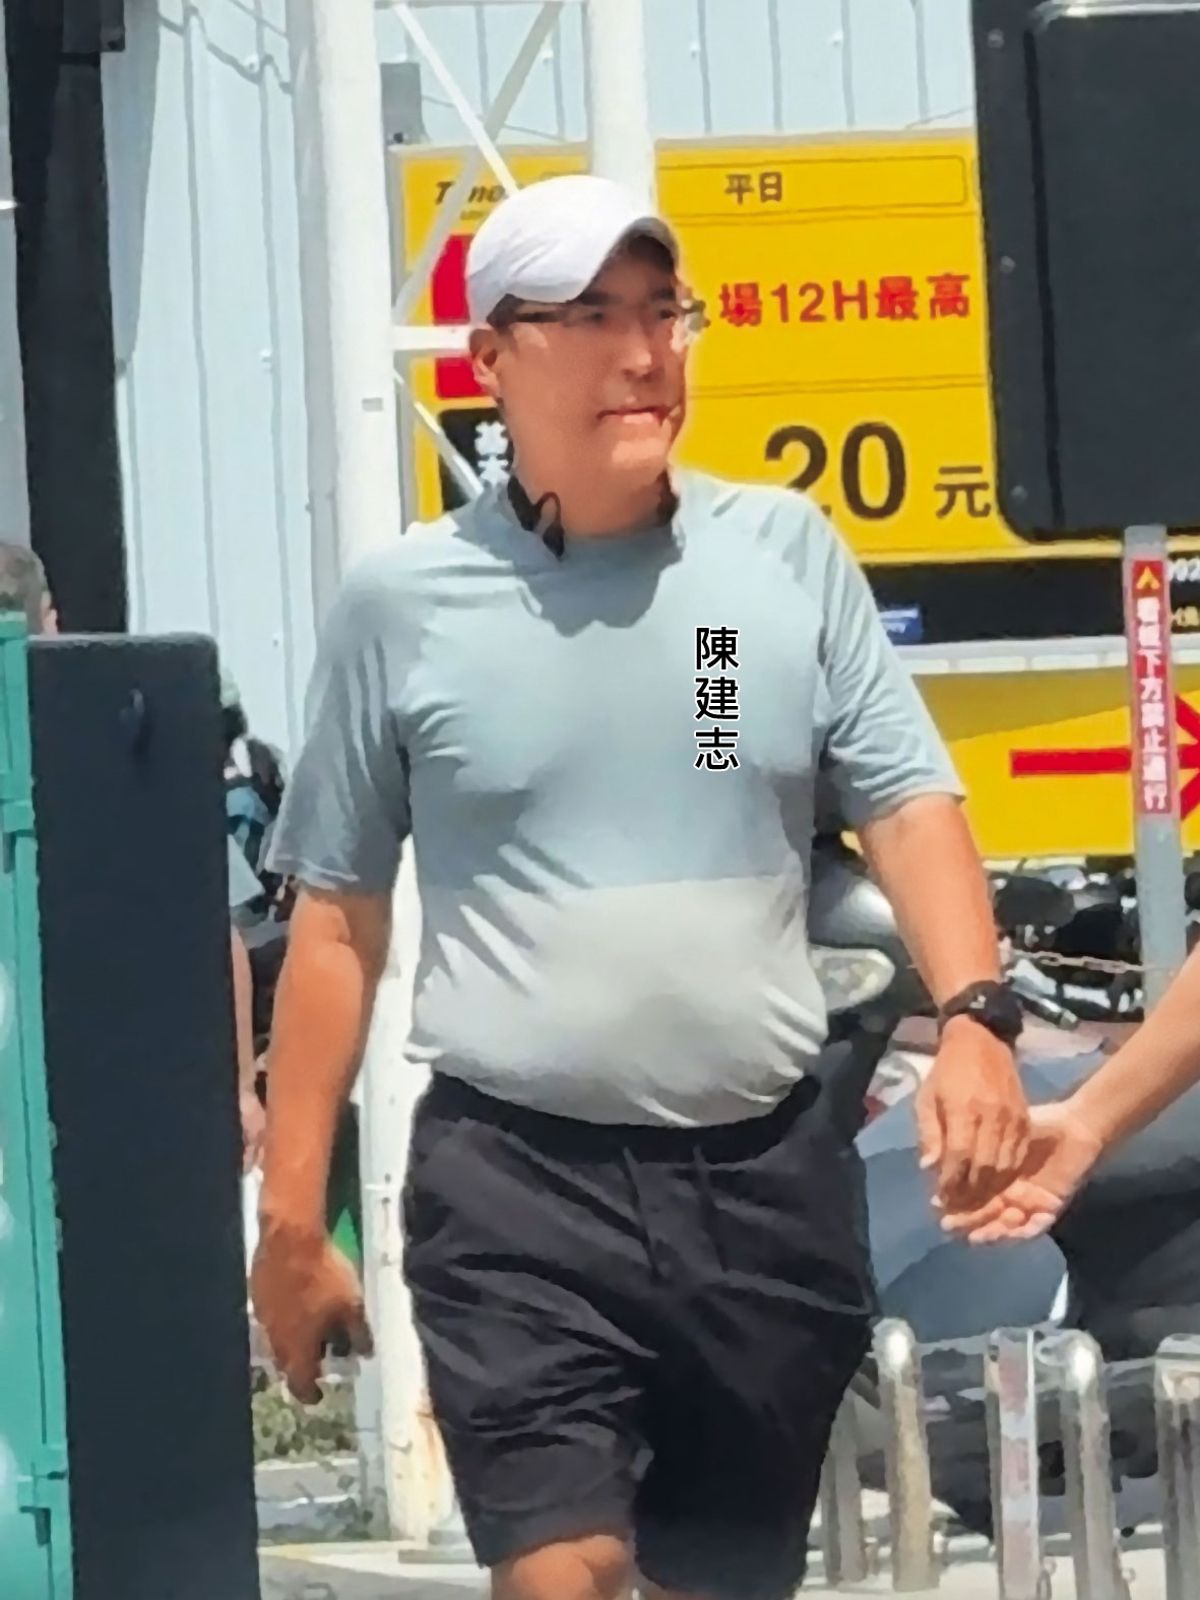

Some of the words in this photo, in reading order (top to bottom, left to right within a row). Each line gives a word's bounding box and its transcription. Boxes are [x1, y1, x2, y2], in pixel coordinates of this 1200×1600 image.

[724, 171, 783, 205] 平日
[718, 272, 971, 328] 場12H最高
[764, 421, 907, 521] 20
[933, 464, 992, 519] 元
